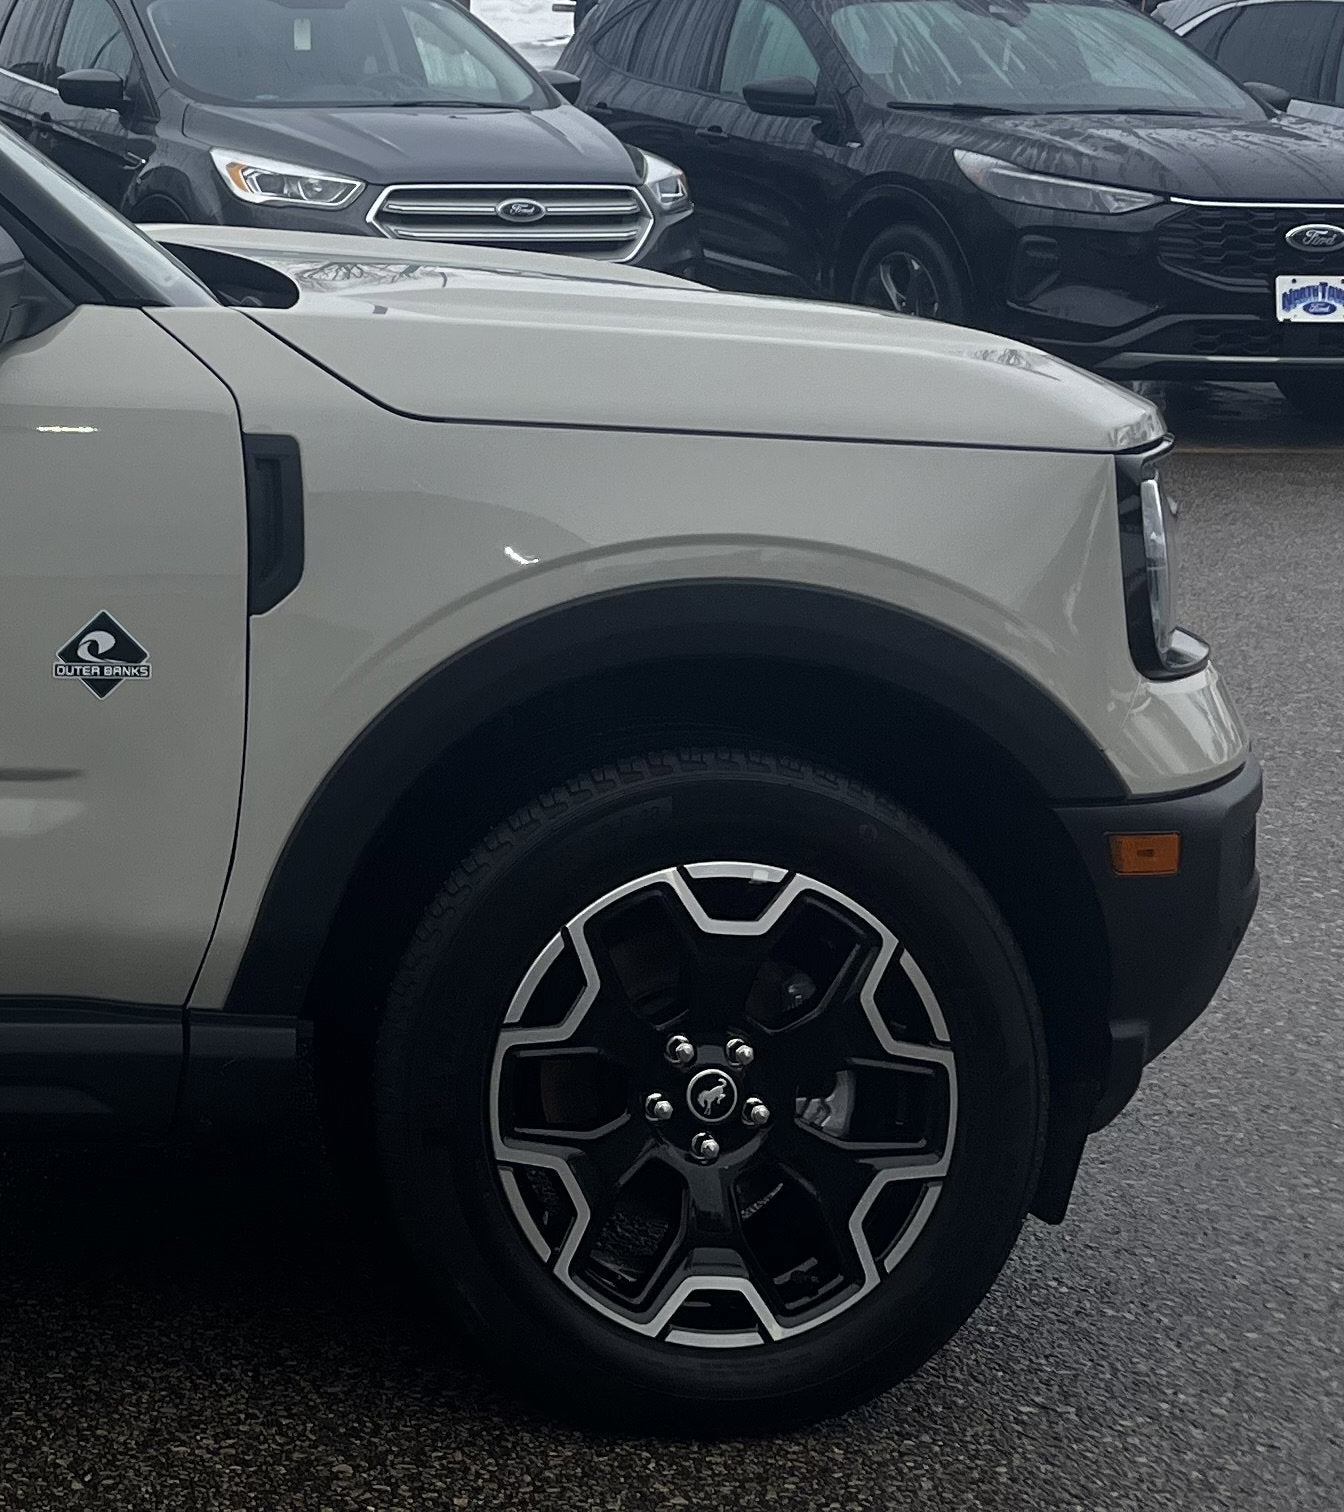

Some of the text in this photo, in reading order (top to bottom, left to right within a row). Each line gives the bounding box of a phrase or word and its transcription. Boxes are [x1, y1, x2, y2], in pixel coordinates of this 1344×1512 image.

[1302, 229, 1338, 246] Ford
[56, 665, 149, 677] OUTER BANKS
